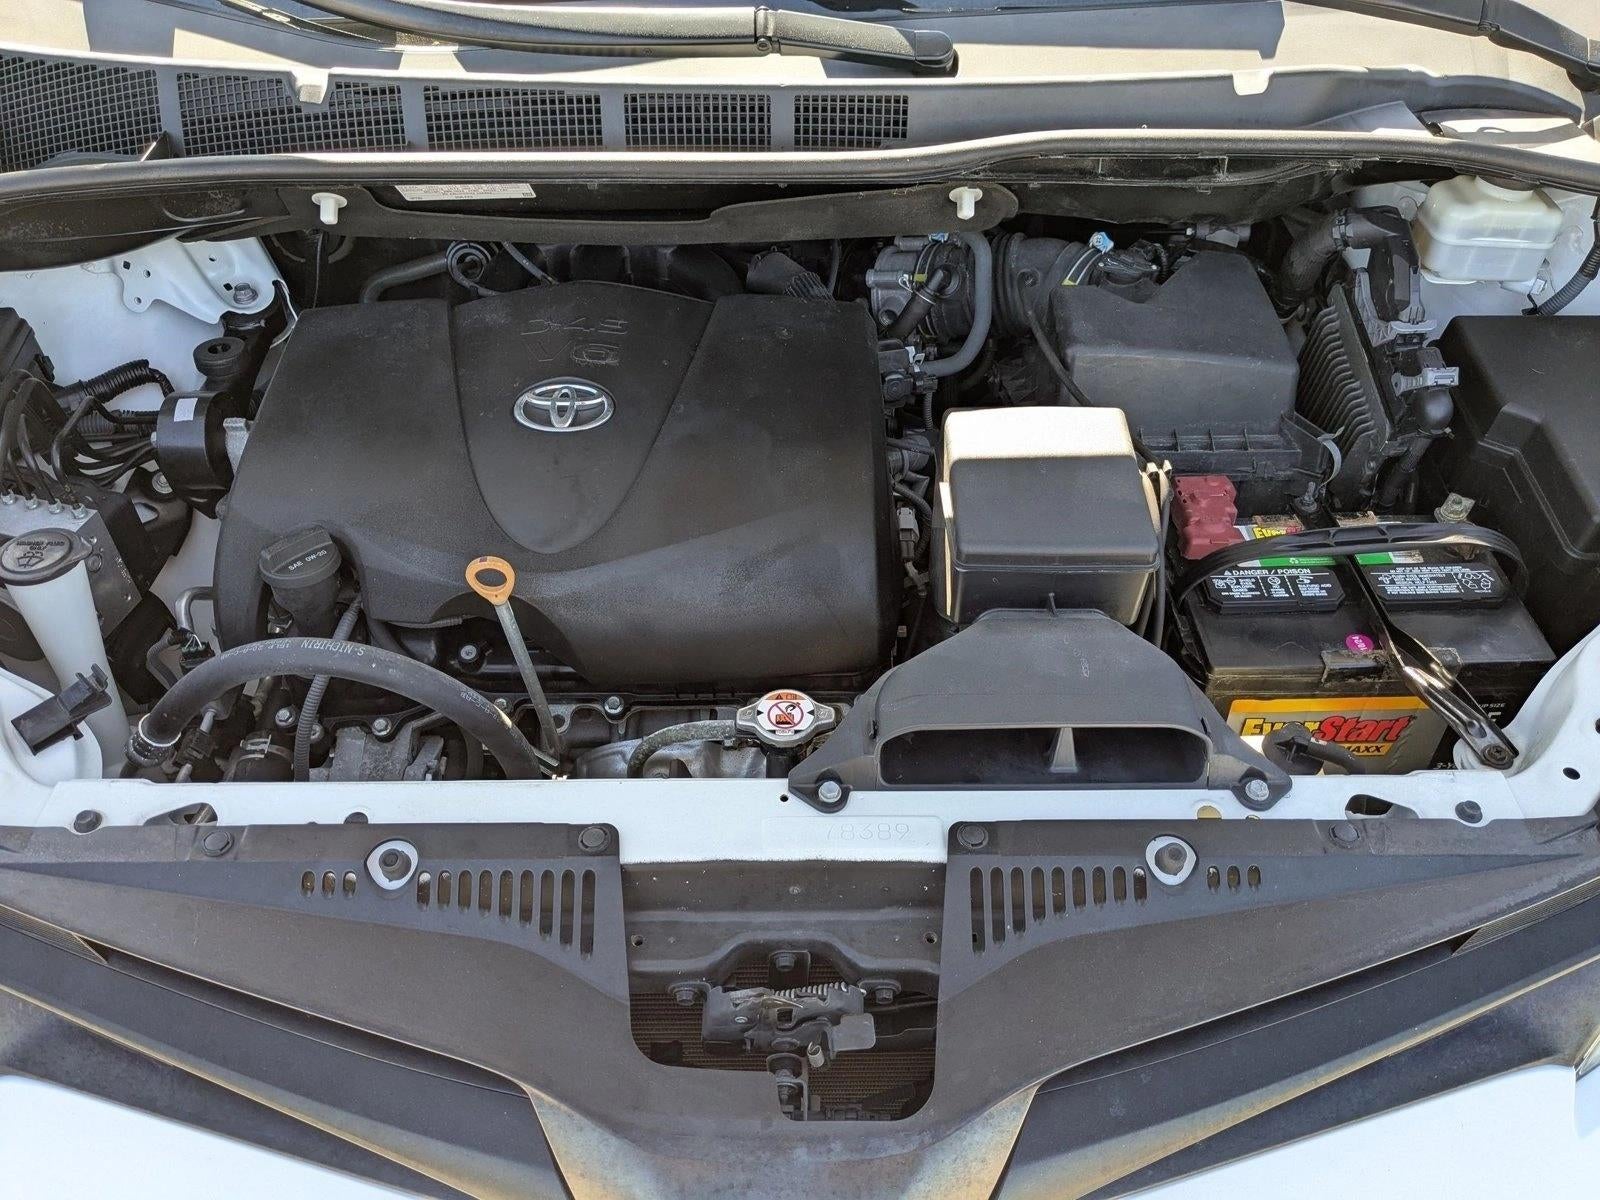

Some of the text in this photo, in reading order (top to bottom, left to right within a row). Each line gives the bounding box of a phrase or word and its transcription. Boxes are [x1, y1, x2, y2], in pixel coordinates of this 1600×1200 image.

[288, 549, 327, 571] SAE 0W-20
[1240, 715, 1413, 742] EvrStart
